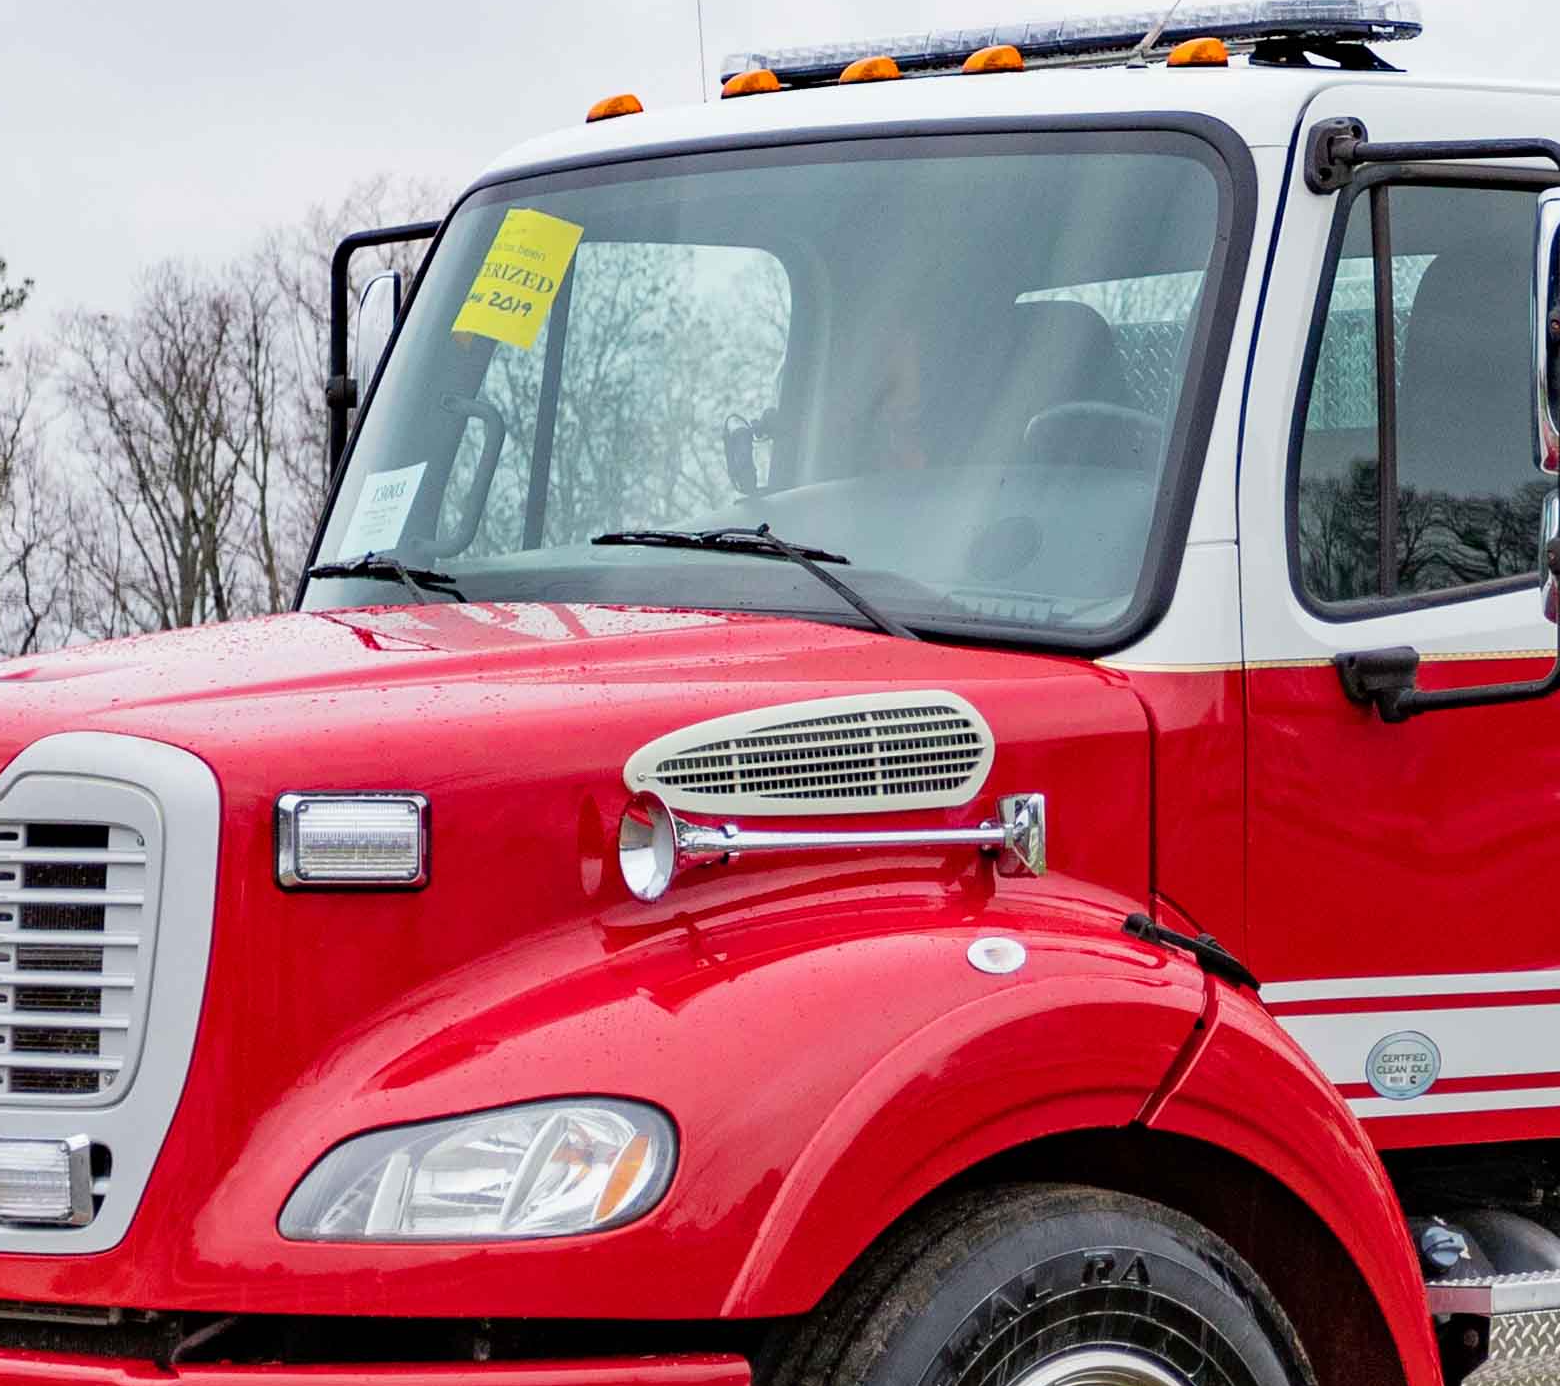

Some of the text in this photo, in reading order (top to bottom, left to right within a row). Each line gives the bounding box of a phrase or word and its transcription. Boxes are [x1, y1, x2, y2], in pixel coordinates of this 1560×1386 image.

[487, 291, 533, 317] 2019
[1381, 1052, 1428, 1064] CERTIFIED
[1375, 1063, 1432, 1075] CLEAN IDLE
